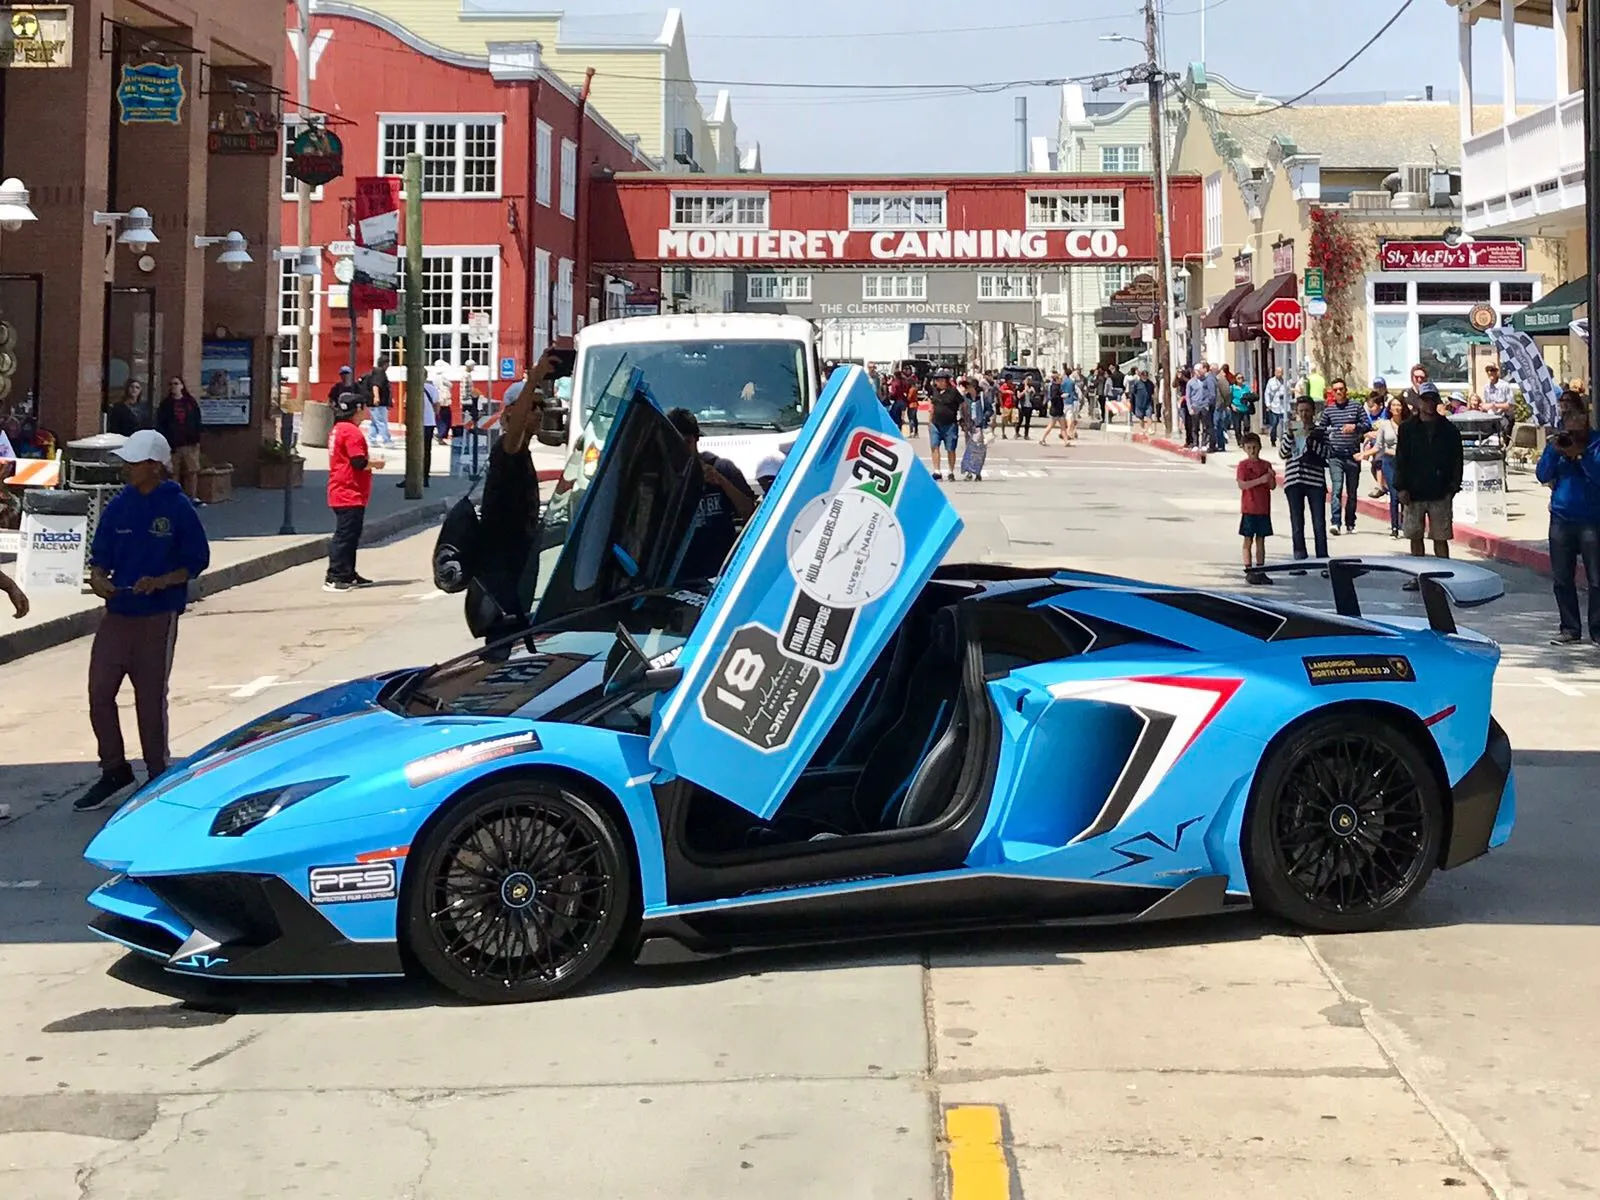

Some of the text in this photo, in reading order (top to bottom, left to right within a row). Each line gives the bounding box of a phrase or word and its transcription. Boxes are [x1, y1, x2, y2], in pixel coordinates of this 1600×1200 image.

[658, 229, 1128, 259] MONTEREY CANNING CO.
[1386, 249, 1466, 266] Sly McFly's
[820, 303, 971, 314] THE CLEMENT MONTEREY
[1266, 312, 1302, 330] STOP
[852, 438, 899, 494] 30
[33, 533, 81, 542] mazda
[33, 542, 80, 550] RACEWAY
[845, 558, 864, 596] ULYSSE
[861, 511, 880, 552] NARDIN
[788, 616, 812, 652] ITALIAN
[803, 605, 832, 658] STAMPEDE
[819, 638, 837, 663] 2017
[717, 647, 766, 711] 18
[1311, 667, 1382, 678] NORTH LOS ANGELES
[765, 687, 799, 746] ADRIAN
[311, 869, 393, 892] PFS
